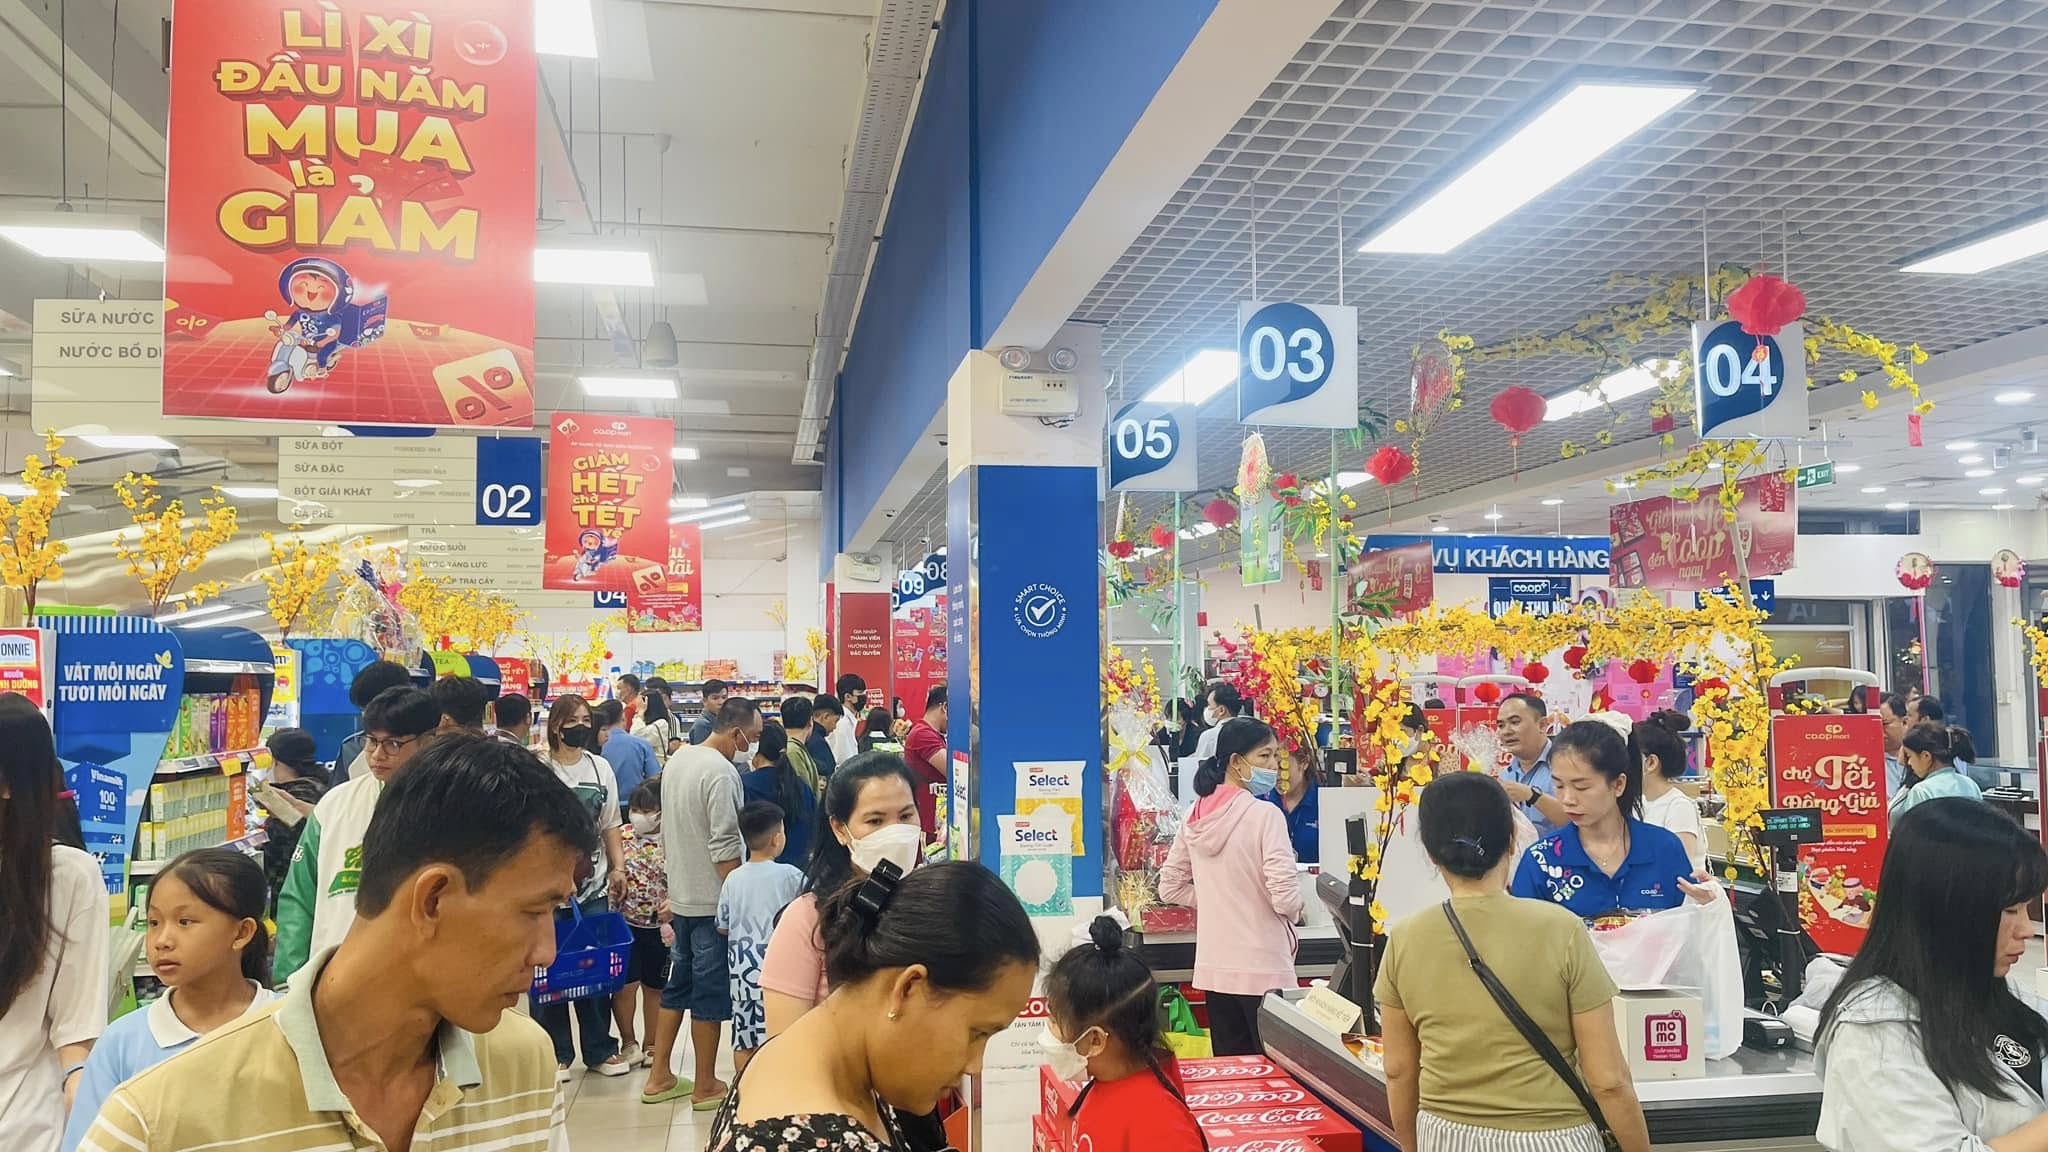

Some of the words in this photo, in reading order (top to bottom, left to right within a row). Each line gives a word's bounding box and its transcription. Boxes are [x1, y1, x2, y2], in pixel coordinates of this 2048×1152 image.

[283, 0, 343, 49] LÌ
[363, 11, 432, 60] XÌ
[216, 51, 342, 95] ĐẦU
[360, 65, 486, 114] NĂM
[246, 103, 474, 173] MUA
[288, 158, 335, 188] là
[219, 174, 479, 260] GIẢM
[61, 307, 97, 324] SỮA
[102, 307, 155, 325] NƯỚC
[59, 342, 113, 358] NƯỚC
[1249, 325, 1325, 383] 03
[1706, 344, 1778, 397] 04
[1116, 418, 1173, 460] 05
[573, 449, 631, 471] GIẢM
[571, 465, 644, 496] HẾT
[1817, 469, 1829, 480] EXIT
[482, 484, 532, 519] 02
[571, 498, 642, 529] TẾT
[1432, 547, 1458, 572] VỤ
[1465, 545, 1542, 569] KHÁCH
[1548, 545, 1611, 569] HÀNG
[901, 578, 925, 595] 09
[1015, 583, 1037, 604] SMART
[1039, 583, 1066, 605] CHOICE
[129, 682, 167, 701] NGÀY
[1029, 774, 1070, 786] Select
[1782, 766, 1812, 783] chợ
[1814, 754, 1876, 790] Tết
[1782, 791, 1842, 816] Đồng
[1839, 791, 1881, 815] Giá
[1015, 828, 1058, 842] Select
[1656, 1022, 1676, 1031] mo
[1656, 1033, 1676, 1042] mo
[1196, 1107, 1326, 1127] Coca-Cola
